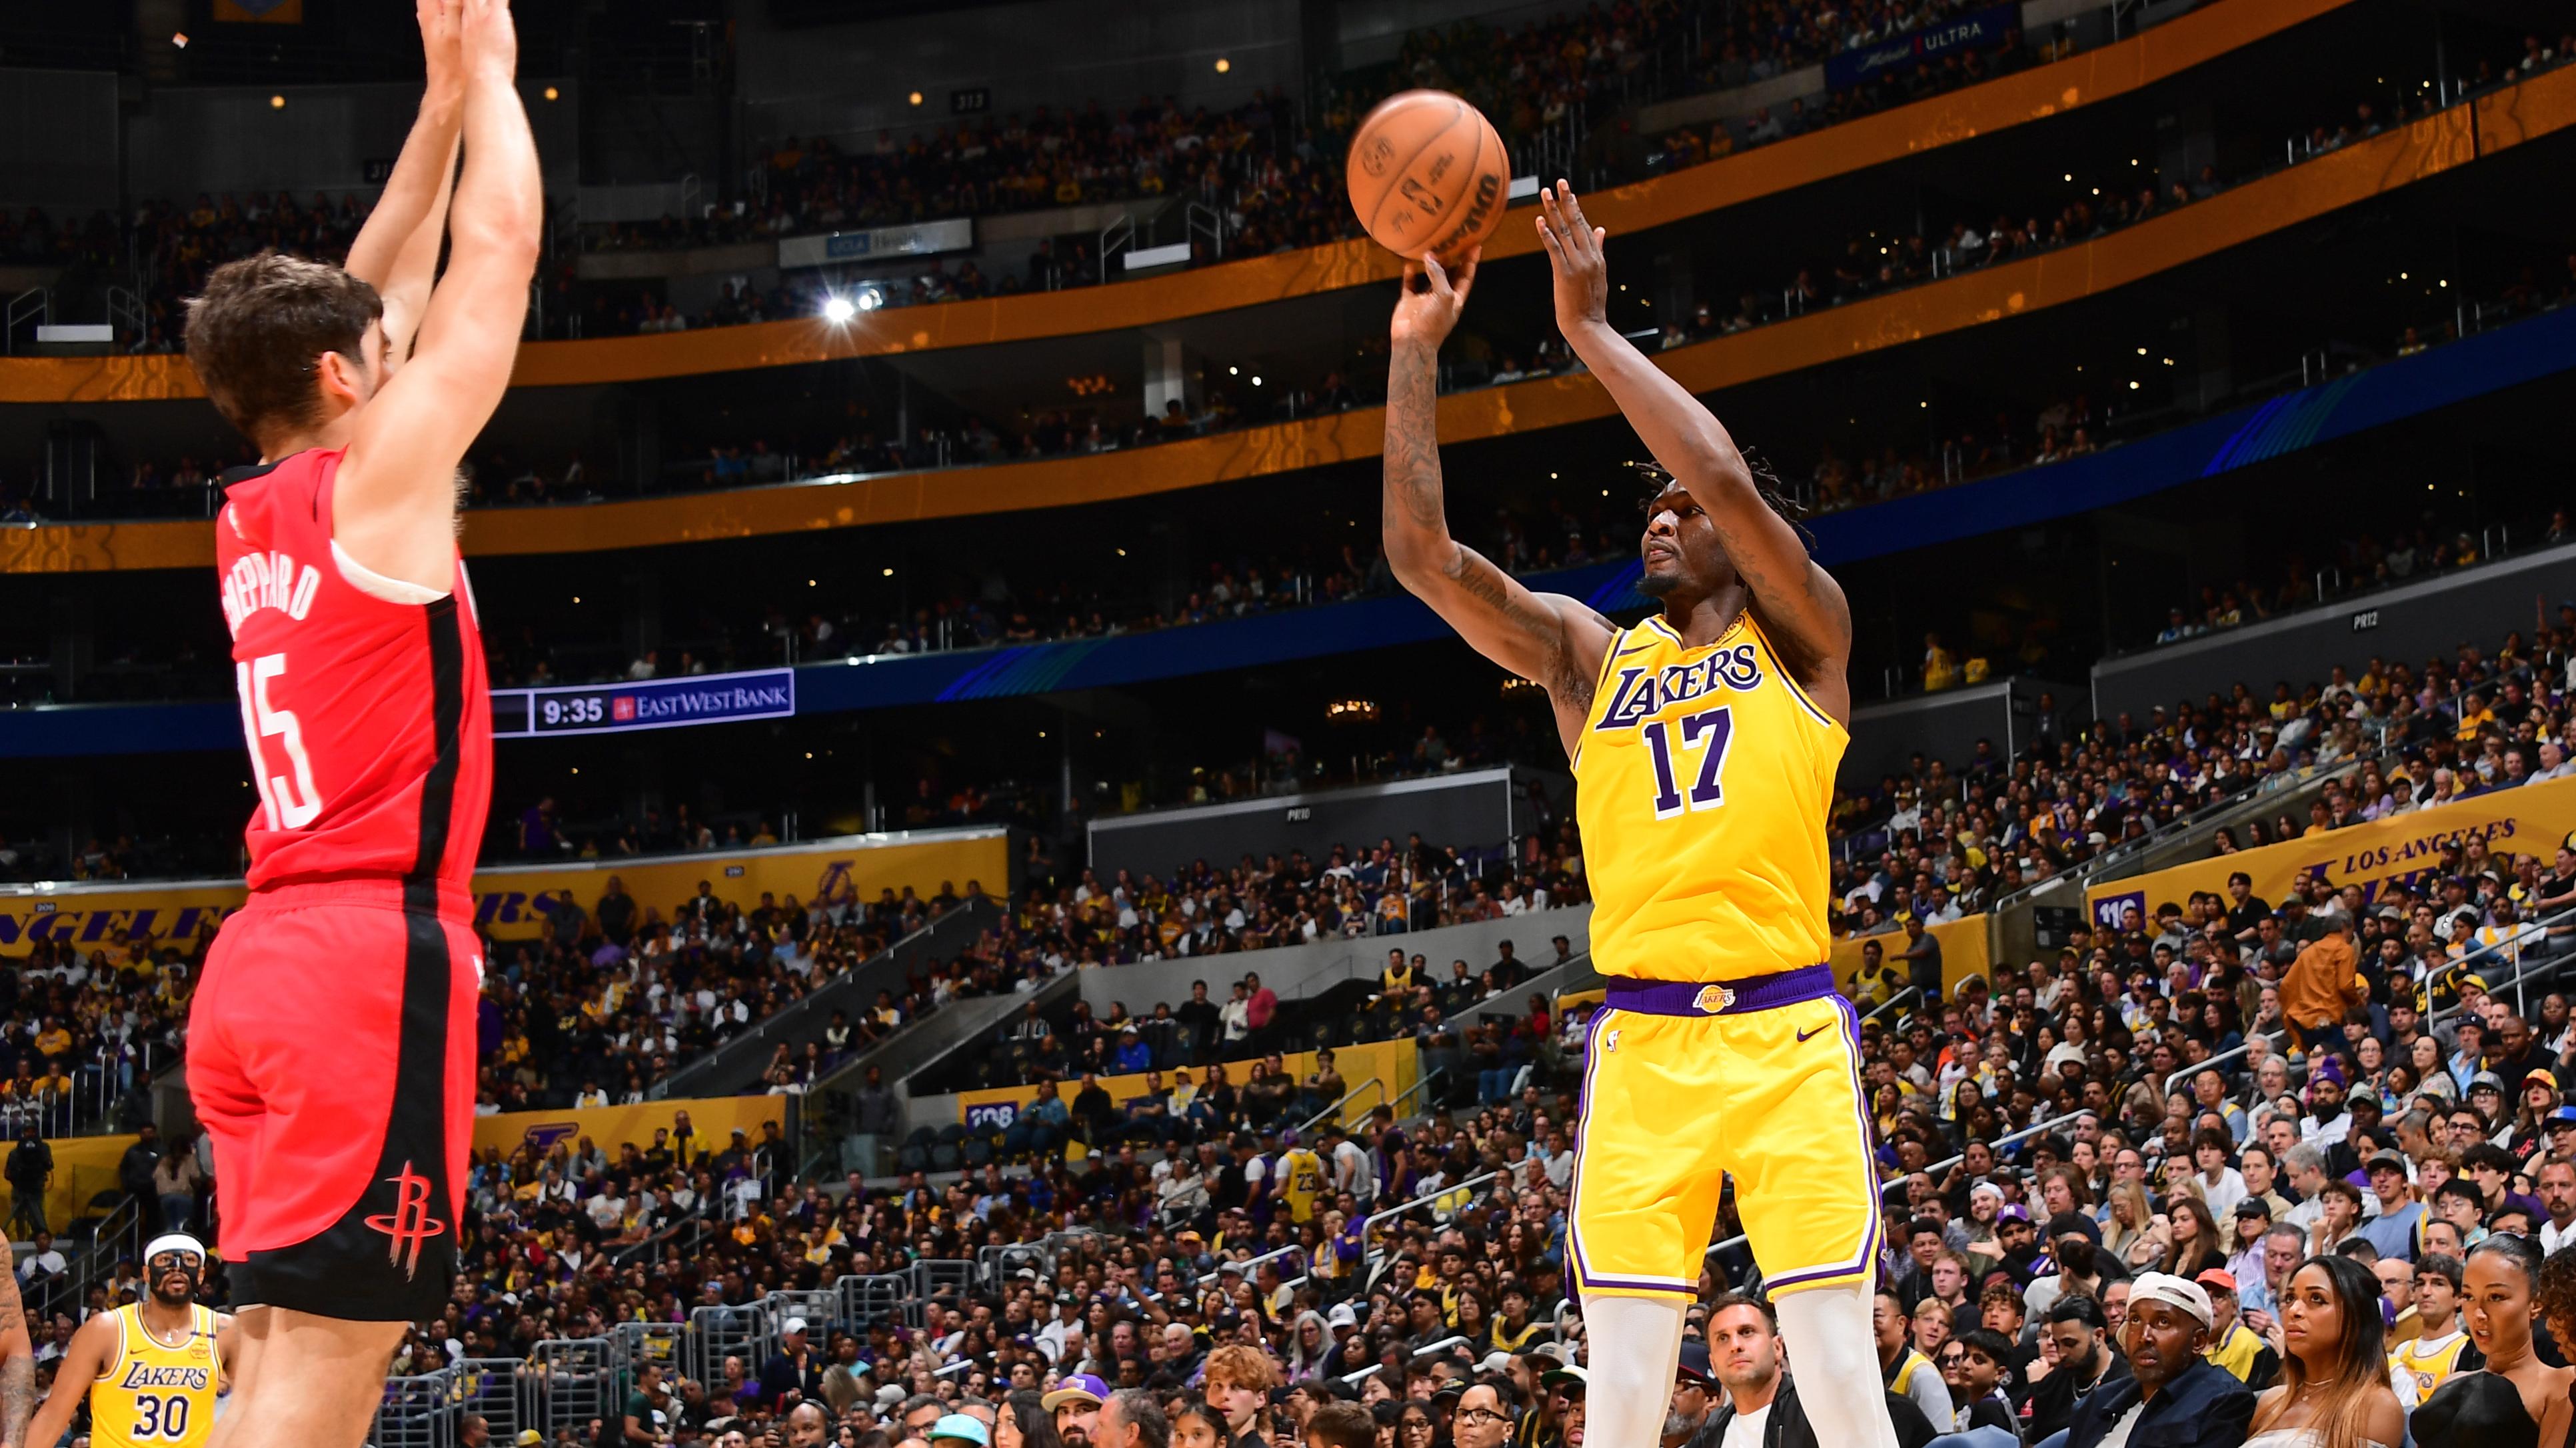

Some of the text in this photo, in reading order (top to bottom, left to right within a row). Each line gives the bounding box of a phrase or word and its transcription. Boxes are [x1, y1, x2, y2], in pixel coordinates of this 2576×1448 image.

[1925, 21, 1984, 51] ULTRA
[222, 550, 321, 642] HEPPARD
[2353, 611, 2378, 630] PR12
[1594, 643, 1764, 732] LAKERS
[543, 697, 603, 723] 9:35
[236, 652, 321, 831] 15
[1642, 703, 1734, 821] 17
[2344, 846, 2389, 874] LOS
[1297, 1173, 1315, 1192] 23
[119, 1361, 209, 1390] LAKERS
[132, 1394, 190, 1440] 30
